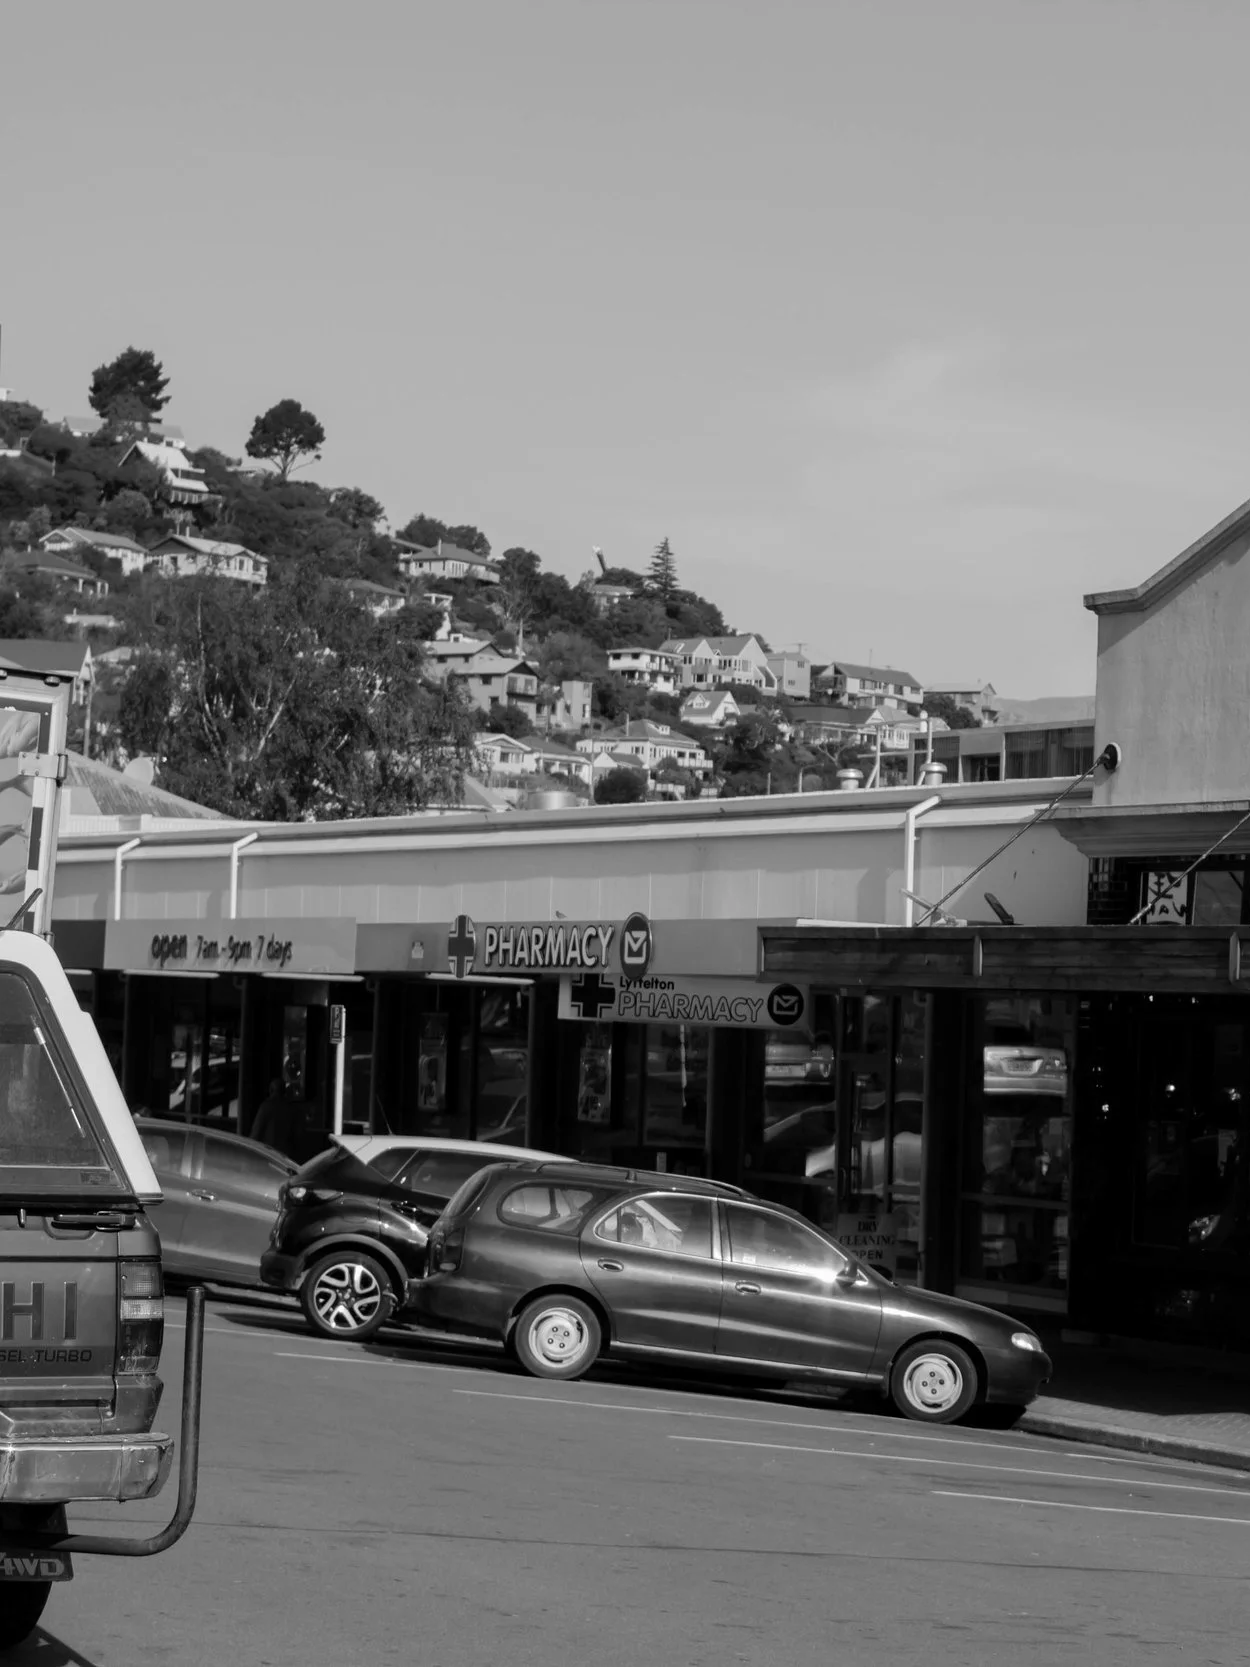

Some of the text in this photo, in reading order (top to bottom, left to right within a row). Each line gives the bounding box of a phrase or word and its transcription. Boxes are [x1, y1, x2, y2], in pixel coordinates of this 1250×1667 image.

[151, 934, 188, 968] open
[257, 934, 265, 960] 7
[267, 932, 293, 968] days
[484, 925, 614, 967] PHARMACY
[620, 975, 675, 991] Lyttelton
[617, 990, 764, 1022] PHARMACY
[857, 1221, 879, 1232] DRY
[839, 1234, 897, 1246] CLEANING
[35, 1349, 92, 1363] TURBO
